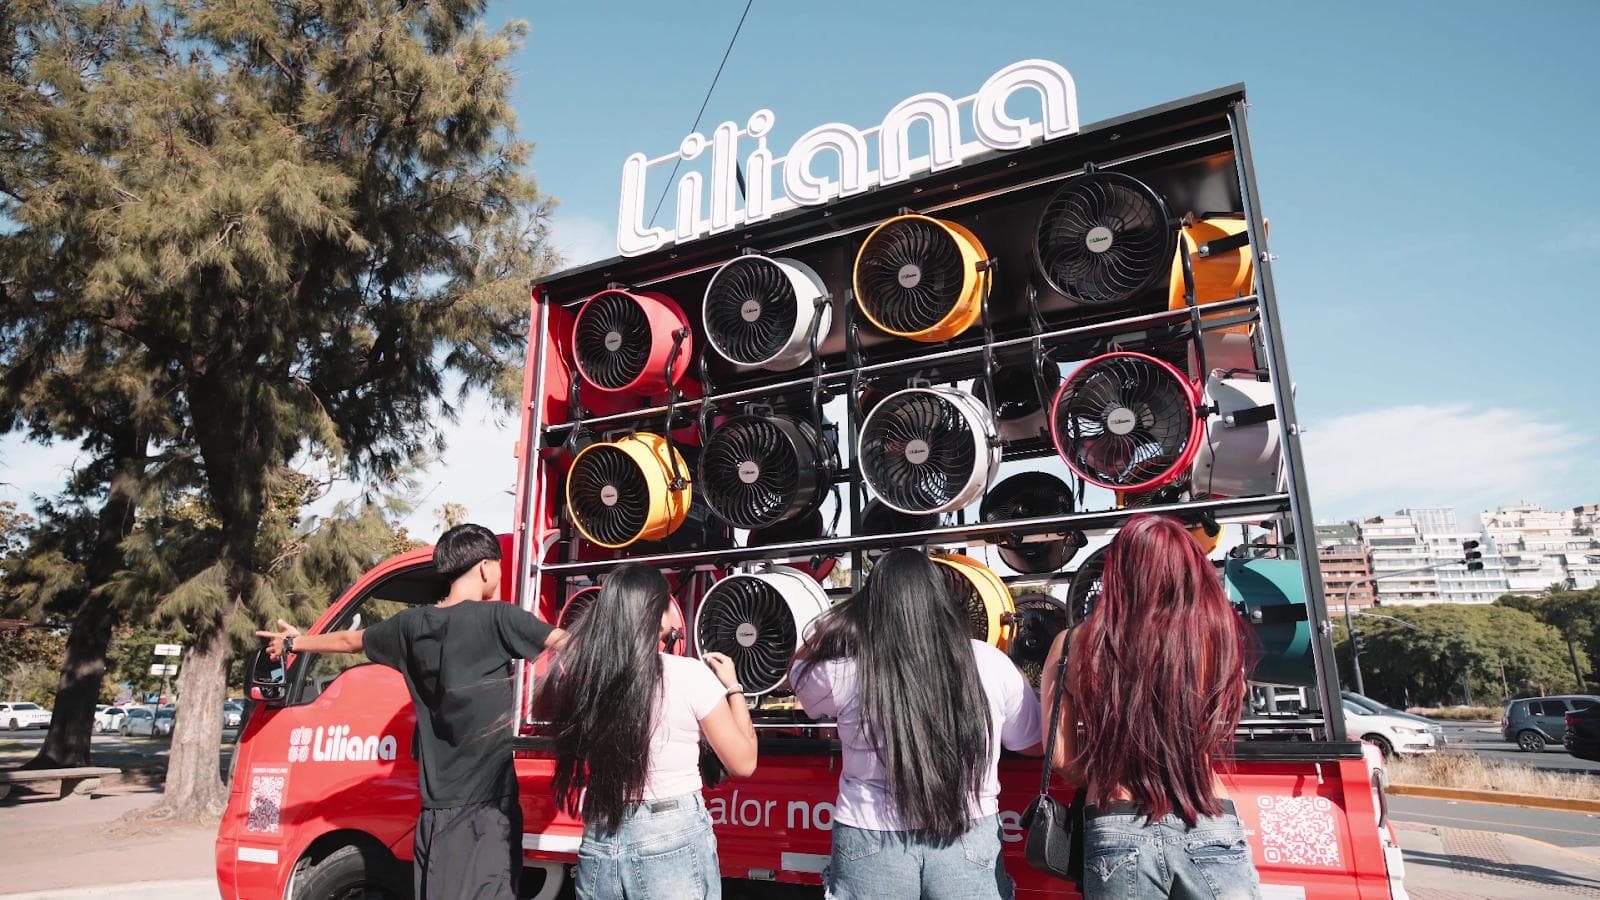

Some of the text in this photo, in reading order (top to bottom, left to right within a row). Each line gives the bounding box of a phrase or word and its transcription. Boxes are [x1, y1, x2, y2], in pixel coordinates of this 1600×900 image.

[617, 59, 1079, 257] Liliana
[313, 725, 397, 761] Liliana
[709, 790, 777, 828] alor
